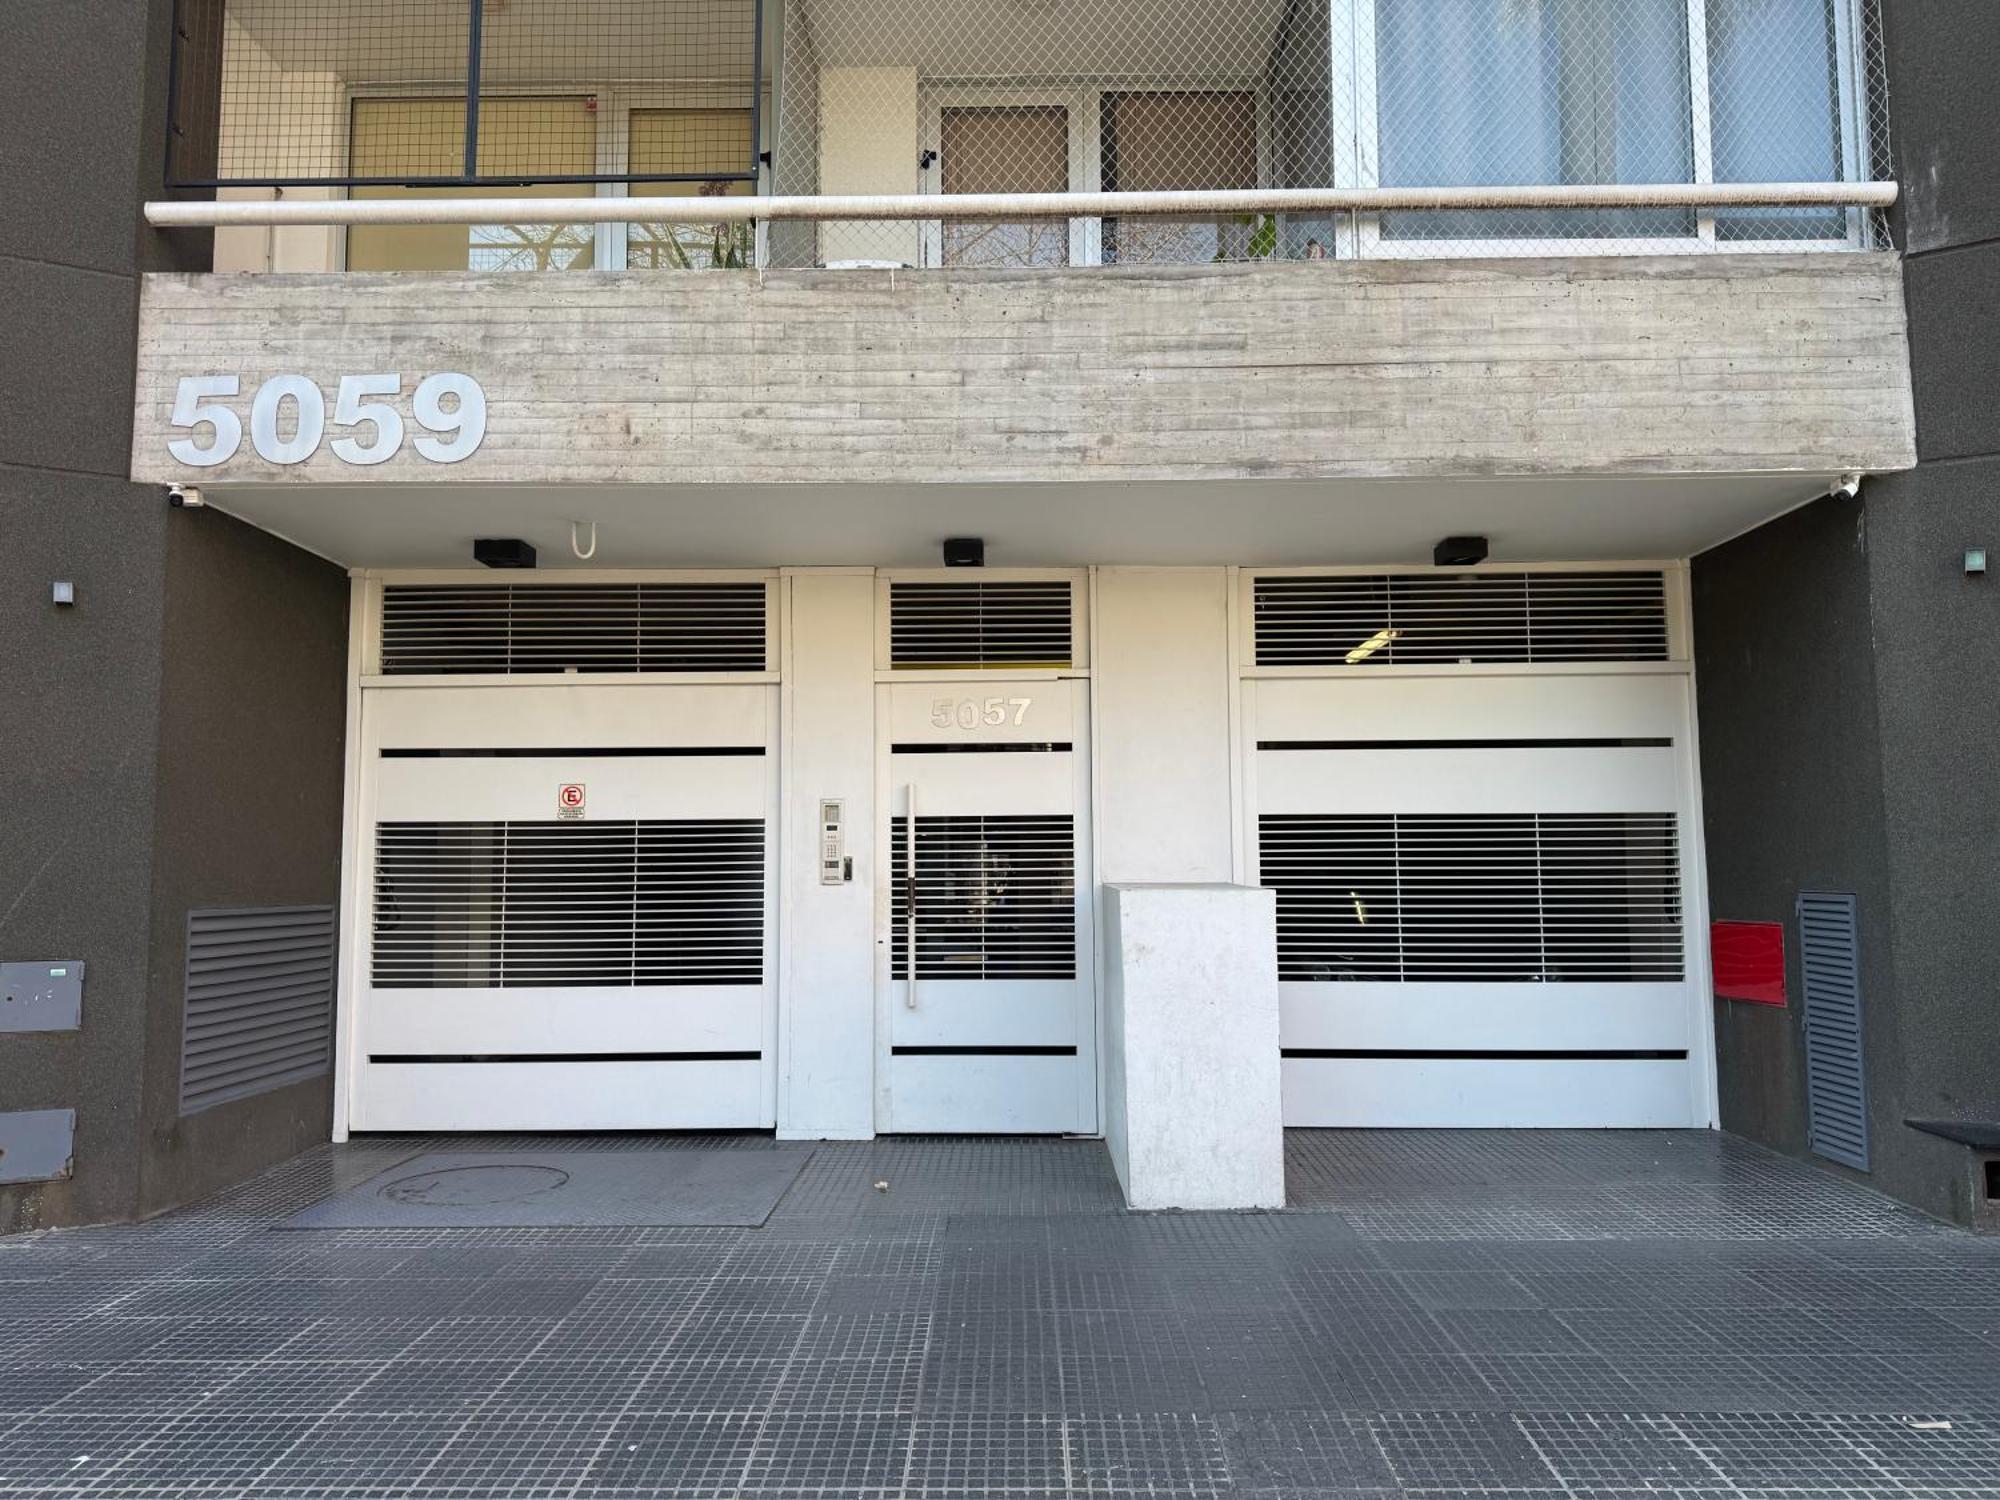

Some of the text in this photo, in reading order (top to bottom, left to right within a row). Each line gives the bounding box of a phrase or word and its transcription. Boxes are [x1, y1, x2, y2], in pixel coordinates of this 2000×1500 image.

[167, 372, 487, 466] 5059
[930, 696, 1032, 729] 5057
[568, 790, 577, 802] E
